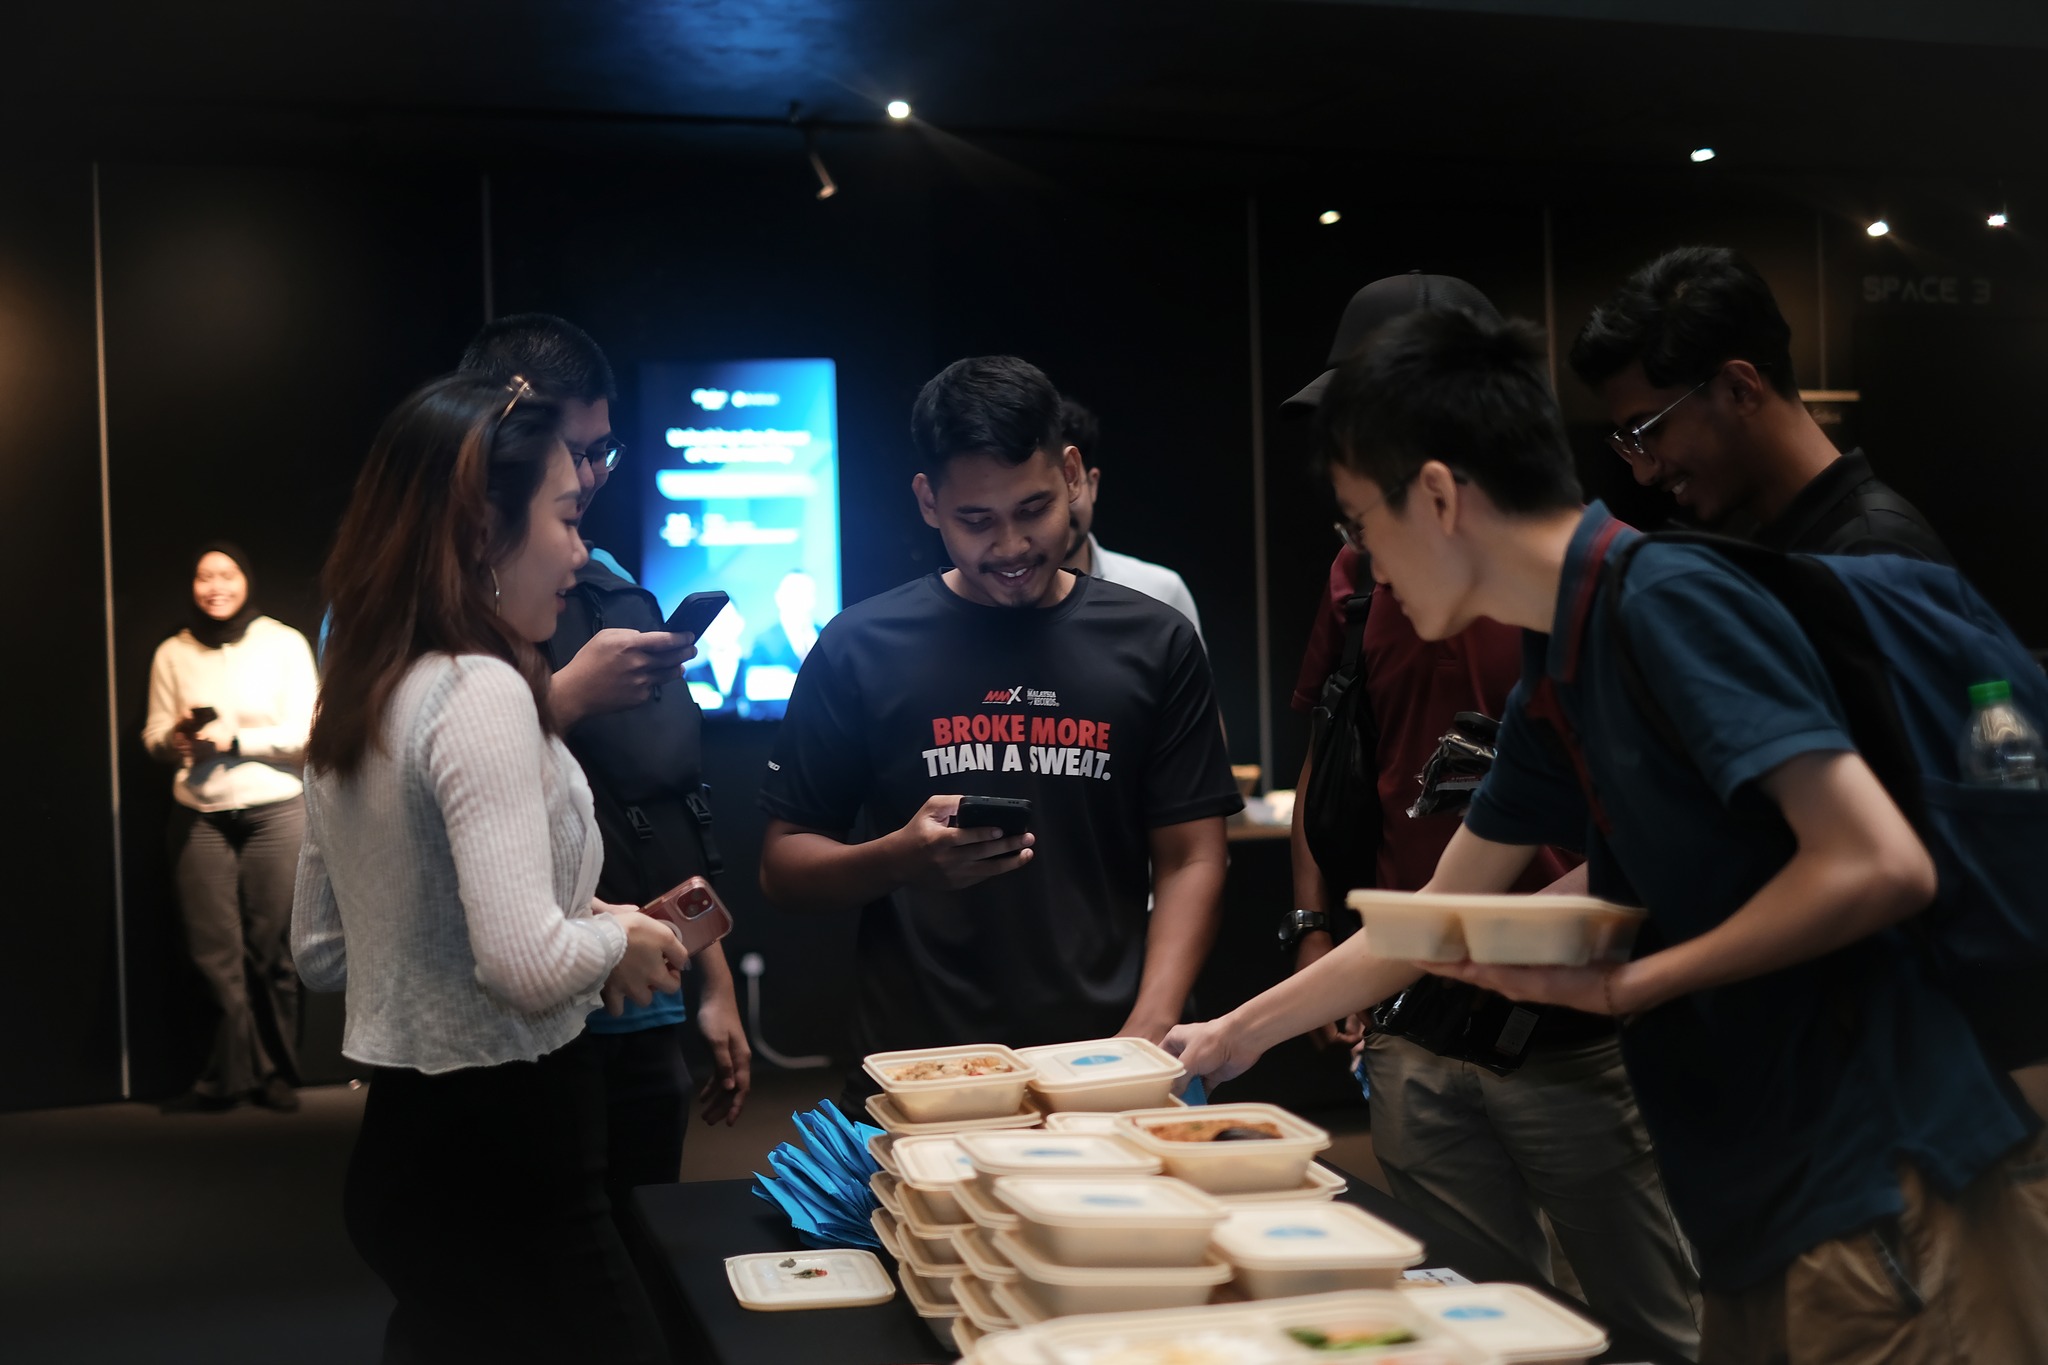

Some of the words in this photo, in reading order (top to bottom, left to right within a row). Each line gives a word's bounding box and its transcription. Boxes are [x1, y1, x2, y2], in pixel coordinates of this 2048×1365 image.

[1863, 274, 1959, 304] SPACE
[1971, 276, 1991, 304] 3
[932, 714, 1025, 746] BROKE
[1030, 716, 1111, 750] MORE
[922, 743, 994, 777] THAN
[1001, 744, 1023, 772] A
[1029, 745, 1112, 781] SWEAT.
